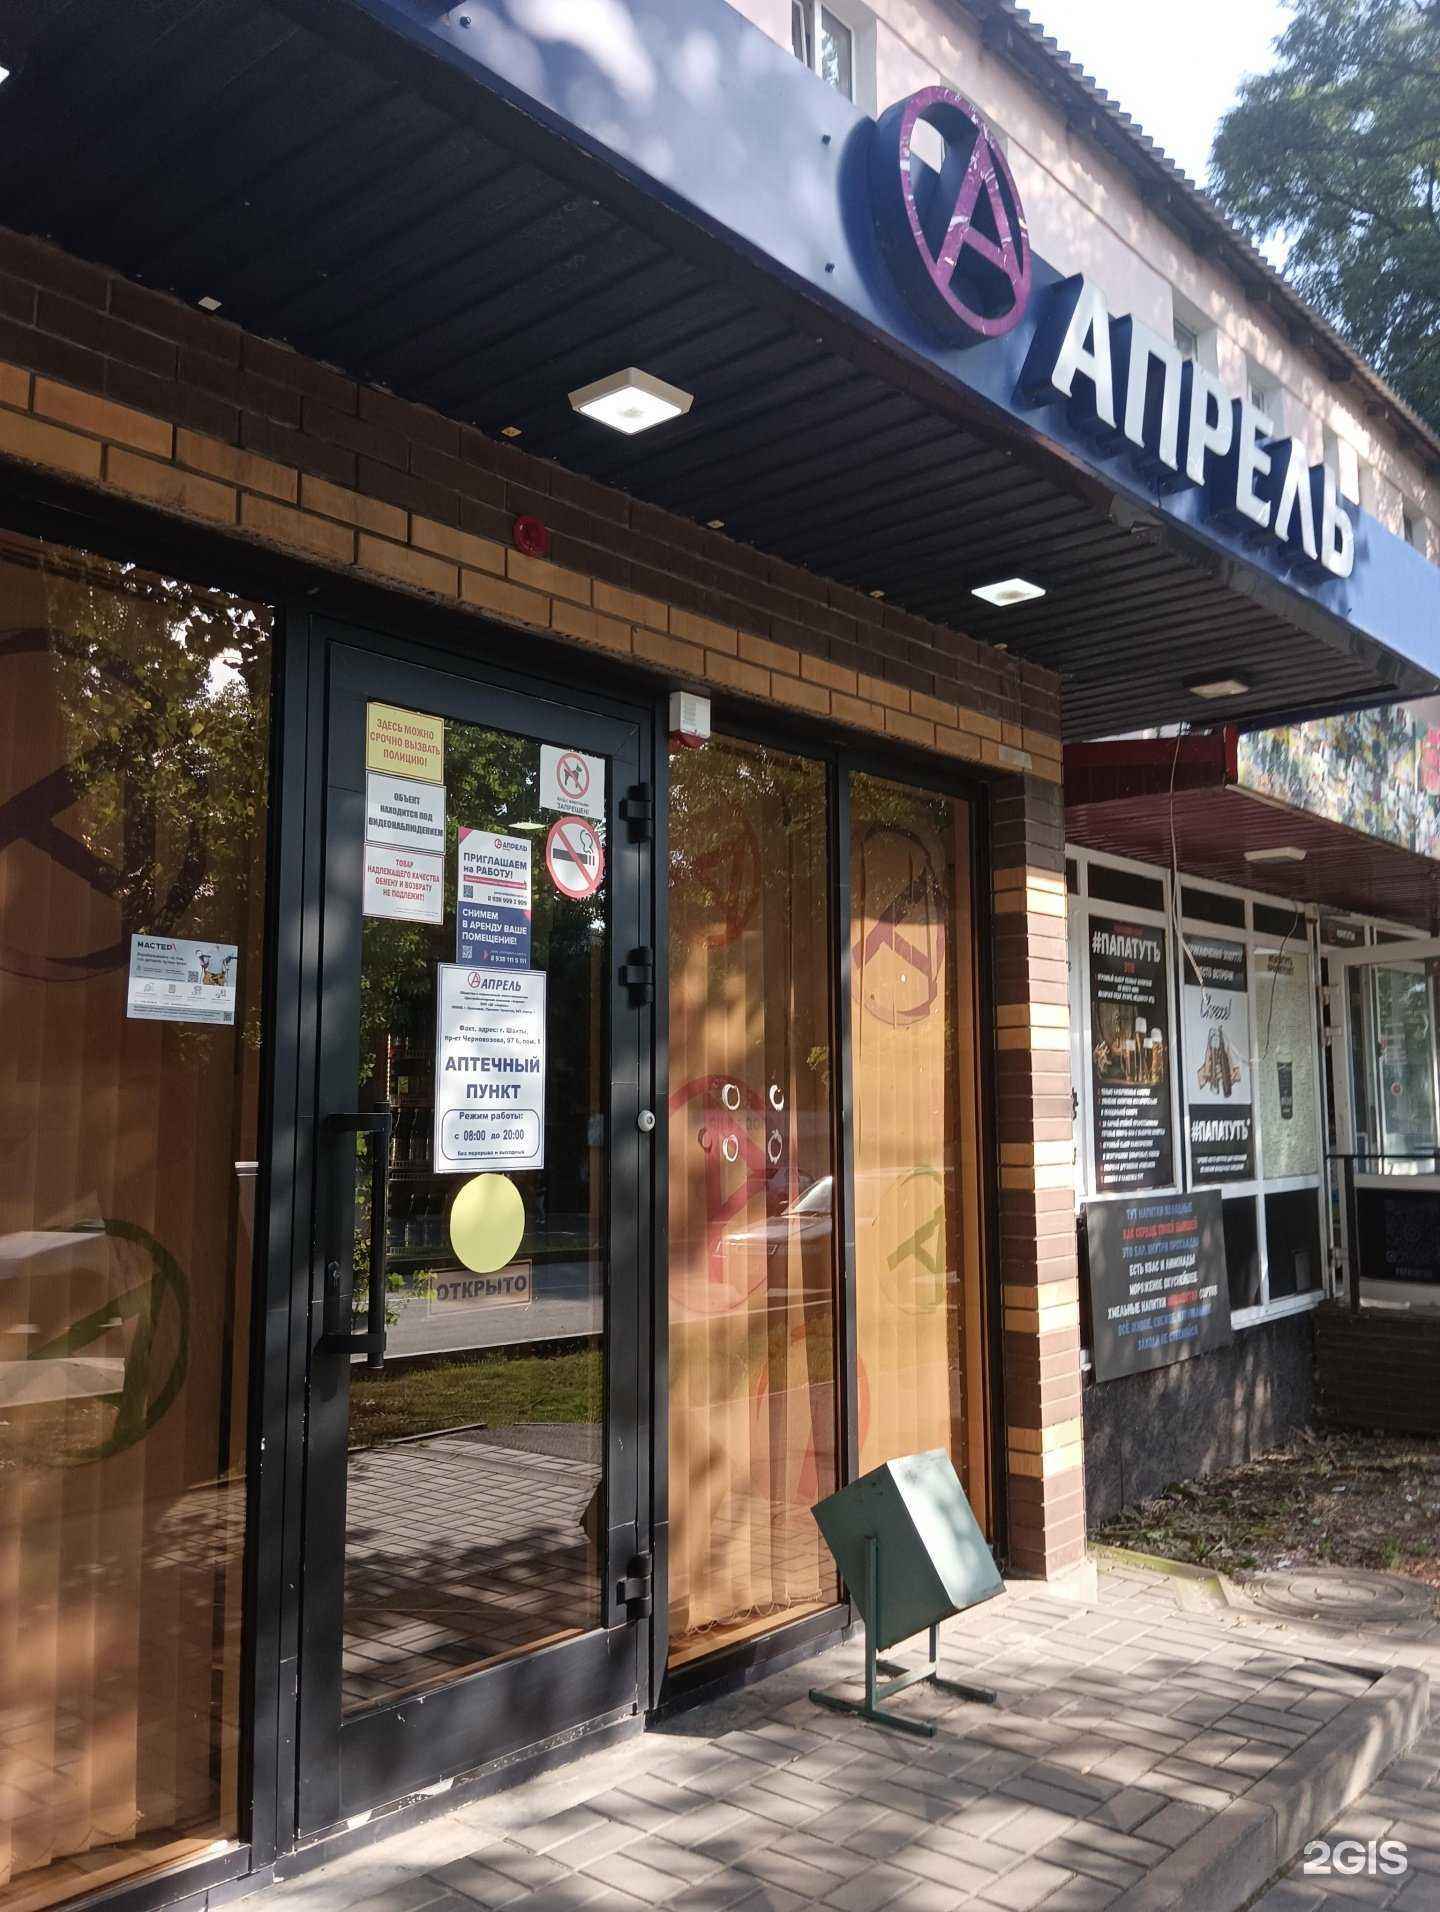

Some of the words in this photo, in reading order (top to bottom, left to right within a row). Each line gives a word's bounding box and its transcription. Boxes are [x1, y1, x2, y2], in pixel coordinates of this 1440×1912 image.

[1051, 275, 1355, 578] АПРЕЛЬ
[377, 718, 402, 732] ЗДЕСЬ
[404, 724, 434, 740] МОЖНО
[370, 732, 403, 748] СРОЧНО
[404, 740, 441, 756] ВЫЗВАТЬ
[383, 749, 427, 768] ПОЛИЦИЮ!
[393, 792, 421, 805] ОБЪЕКТ
[380, 804, 419, 818] НАХОДИТСЯ
[419, 812, 433, 823] ПОД
[368, 816, 444, 837] ВИДЕОНАБЛЮДЕНИЕМ
[395, 859, 414, 869] ТОВАР
[463, 852, 528, 870] ПРИГЛАШАЕМ
[367, 864, 411, 879] НАДЛЕЖАЩЕГО
[411, 871, 440, 883] КАЧЕСТВА
[463, 865, 474, 873] на
[476, 865, 513, 879] РАБОТУ!
[375, 876, 398, 888] ОБМЕНУ
[399, 880, 404, 888] И
[404, 880, 432, 892] ВОЗВРАТУ
[383, 888, 390, 897] НЕ
[391, 889, 425, 901] ПОДЛЕЖИТ!
[462, 908, 499, 920] СНИМЕМ
[462, 920, 468, 928] В
[469, 921, 502, 933] АРЕНДУ
[504, 924, 528, 935] ВАШЕ
[462, 931, 517, 945] ПОМЕЩЕНИЕ!
[1091, 930, 1161, 963] #ПАПАТУТЪ
[480, 979, 521, 991] АПРЕЛЬ
[445, 1056, 540, 1073] АПТЕЧНЫЙ
[466, 1084, 521, 1099] ПУНКТ
[459, 1111, 488, 1120] Режим
[490, 1111, 524, 1122] работы:
[463, 1130, 486, 1141] 08:00
[490, 1132, 501, 1140] до
[502, 1129, 525, 1140] 20:00
[1129, 1263, 1144, 1276] ЕСТЬ
[1144, 1260, 1160, 1273] КВАС
[1160, 1258, 1165, 1271] И
[436, 1275, 527, 1300] ОТКРЫТО
[1107, 1301, 1141, 1320] ХМЕЛЬНЫЕ
[1141, 1296, 1167, 1313] НАПИТКИ
